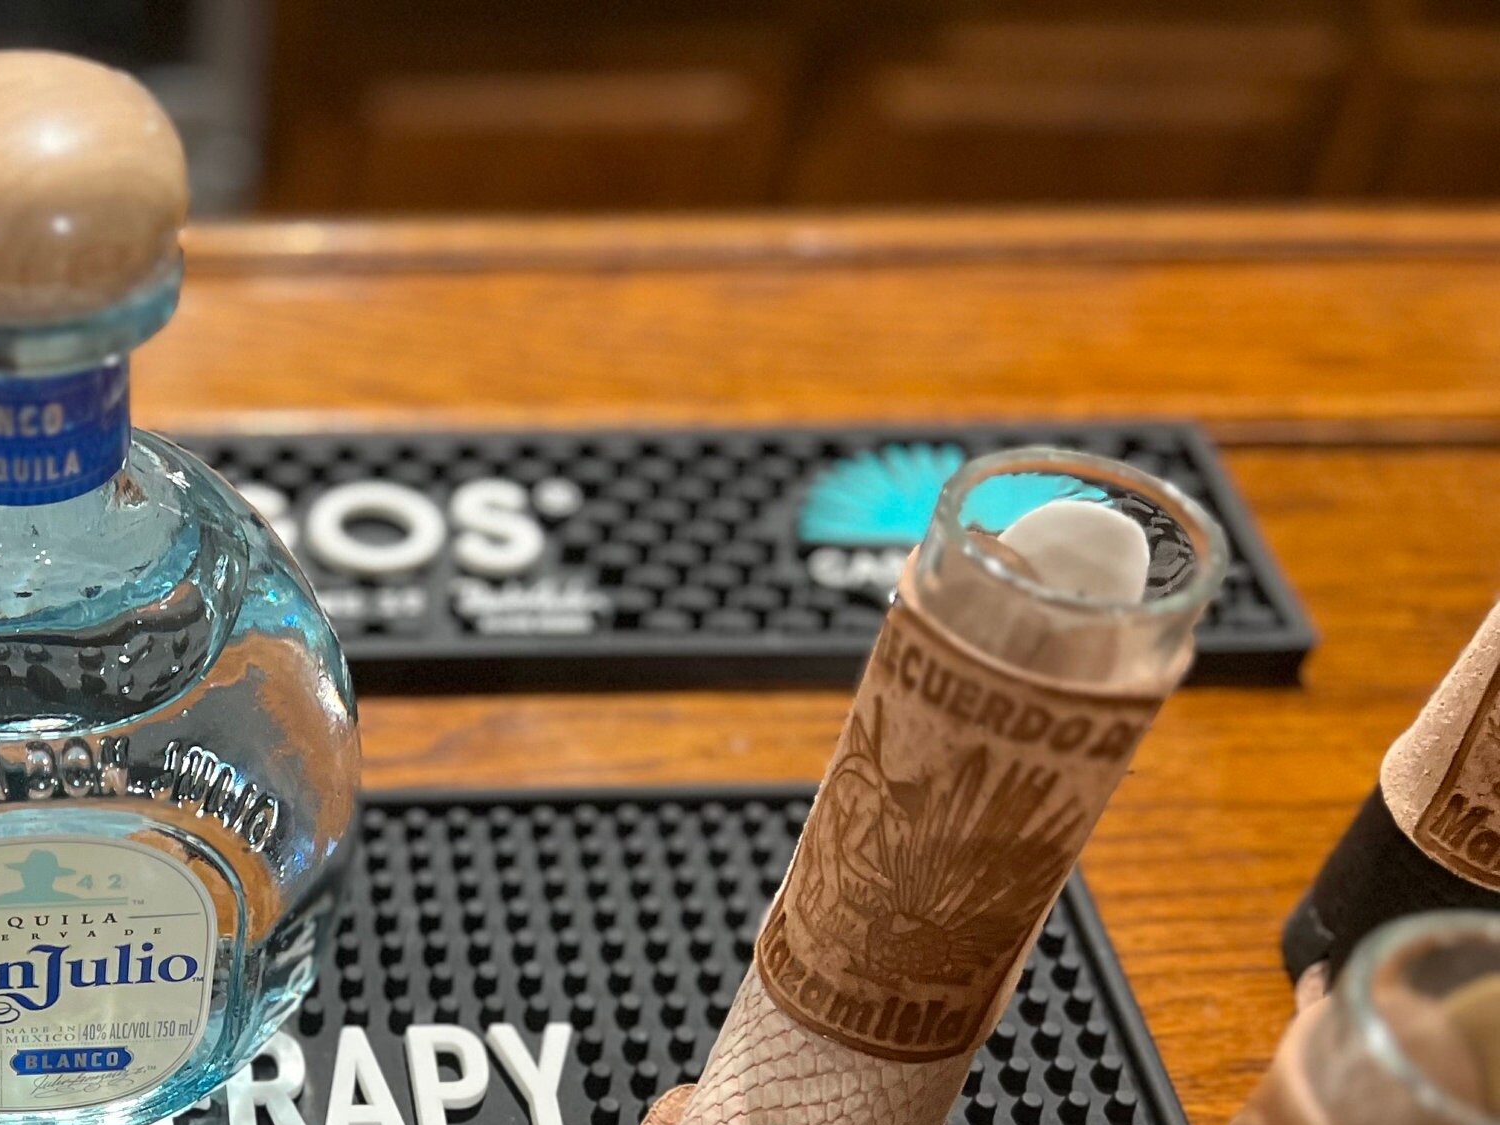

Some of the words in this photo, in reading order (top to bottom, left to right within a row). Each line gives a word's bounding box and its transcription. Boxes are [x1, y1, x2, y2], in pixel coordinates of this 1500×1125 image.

[5, 1026, 49, 1035] MADE
[58, 1025, 76, 1033] IN
[82, 1024, 107, 1041] 40%
[109, 1021, 151, 1040] ALC/VOL
[157, 1020, 176, 1038] 750
[5, 1033, 76, 1044] MEXICO
[25, 1051, 119, 1070] BLANCO
